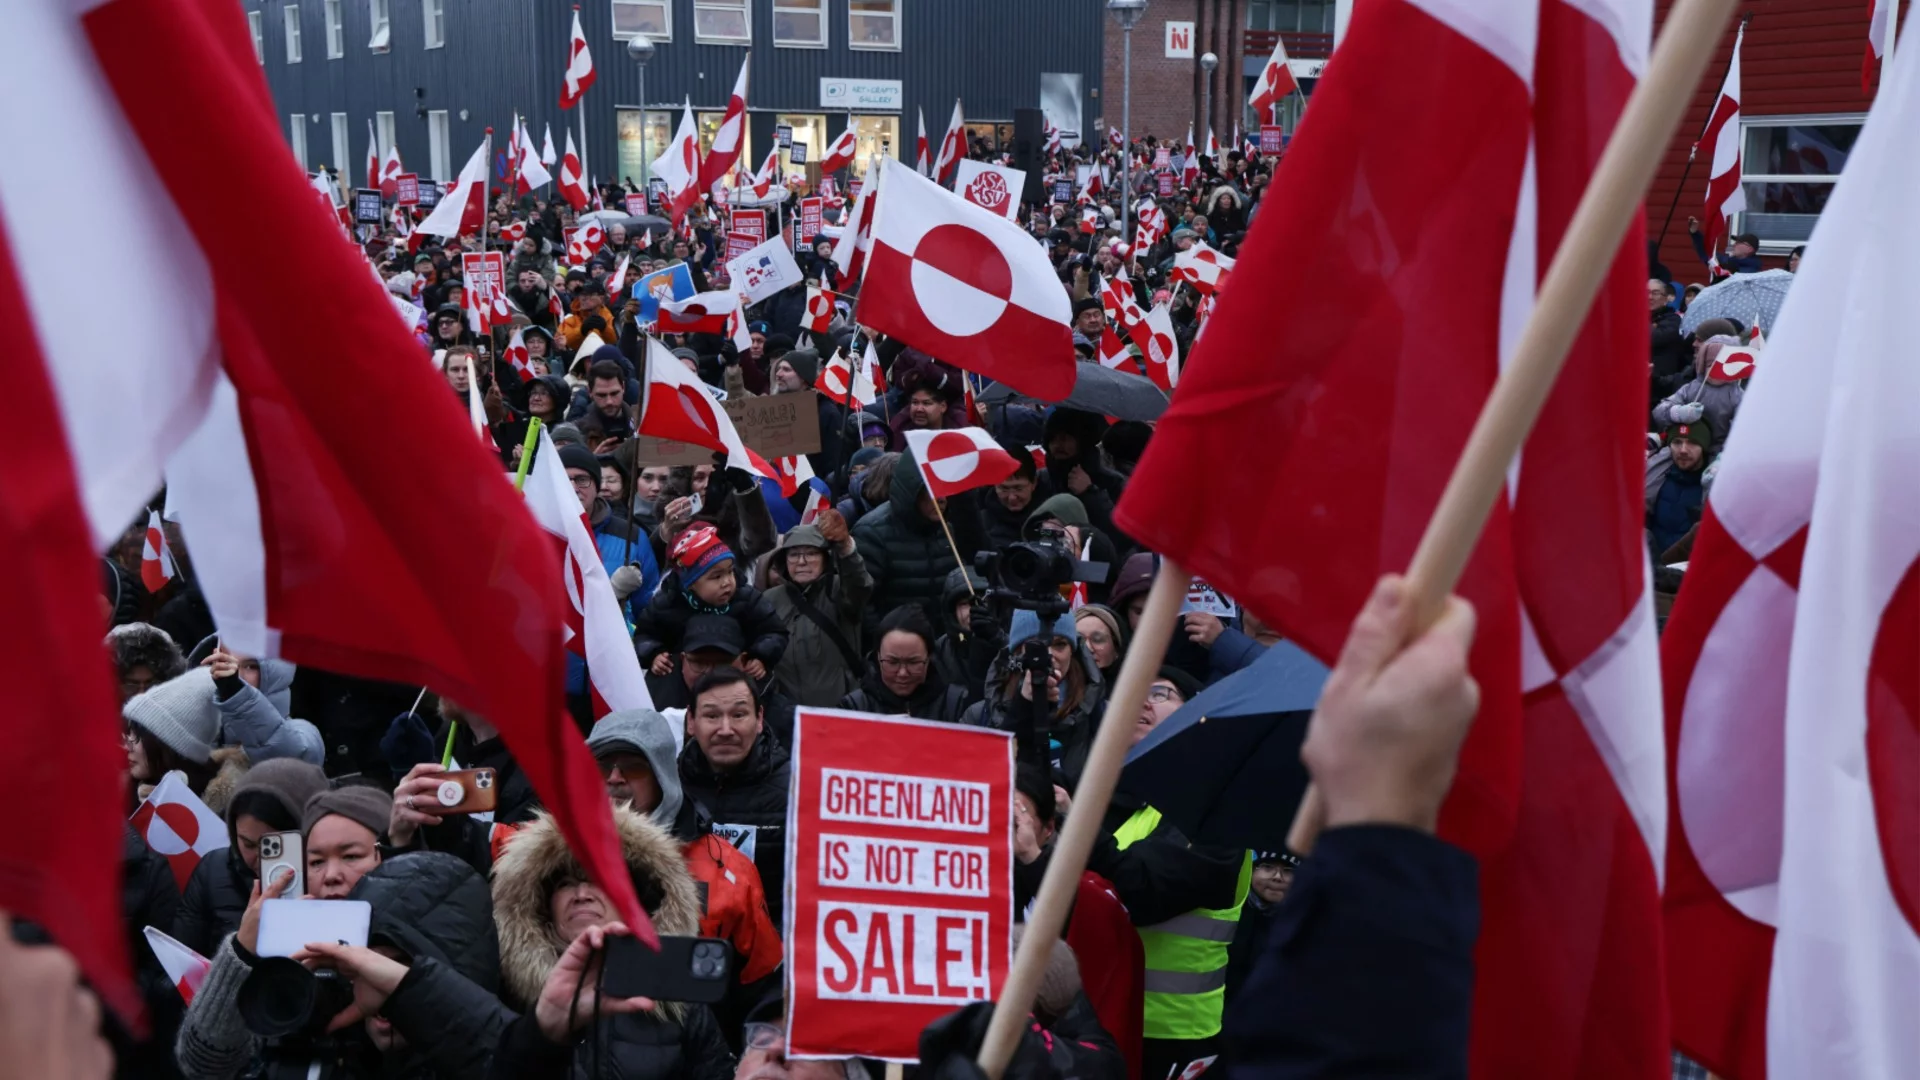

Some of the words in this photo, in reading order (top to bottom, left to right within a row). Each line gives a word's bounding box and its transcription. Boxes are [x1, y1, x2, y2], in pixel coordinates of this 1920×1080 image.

[859, 96, 892, 104] GALLERY
[976, 172, 1005, 193] USA
[825, 774, 984, 826] GREENLAND
[824, 841, 849, 881] IS
[865, 843, 919, 885] NOT
[934, 850, 984, 891] FOR
[822, 907, 985, 999] SALE!
